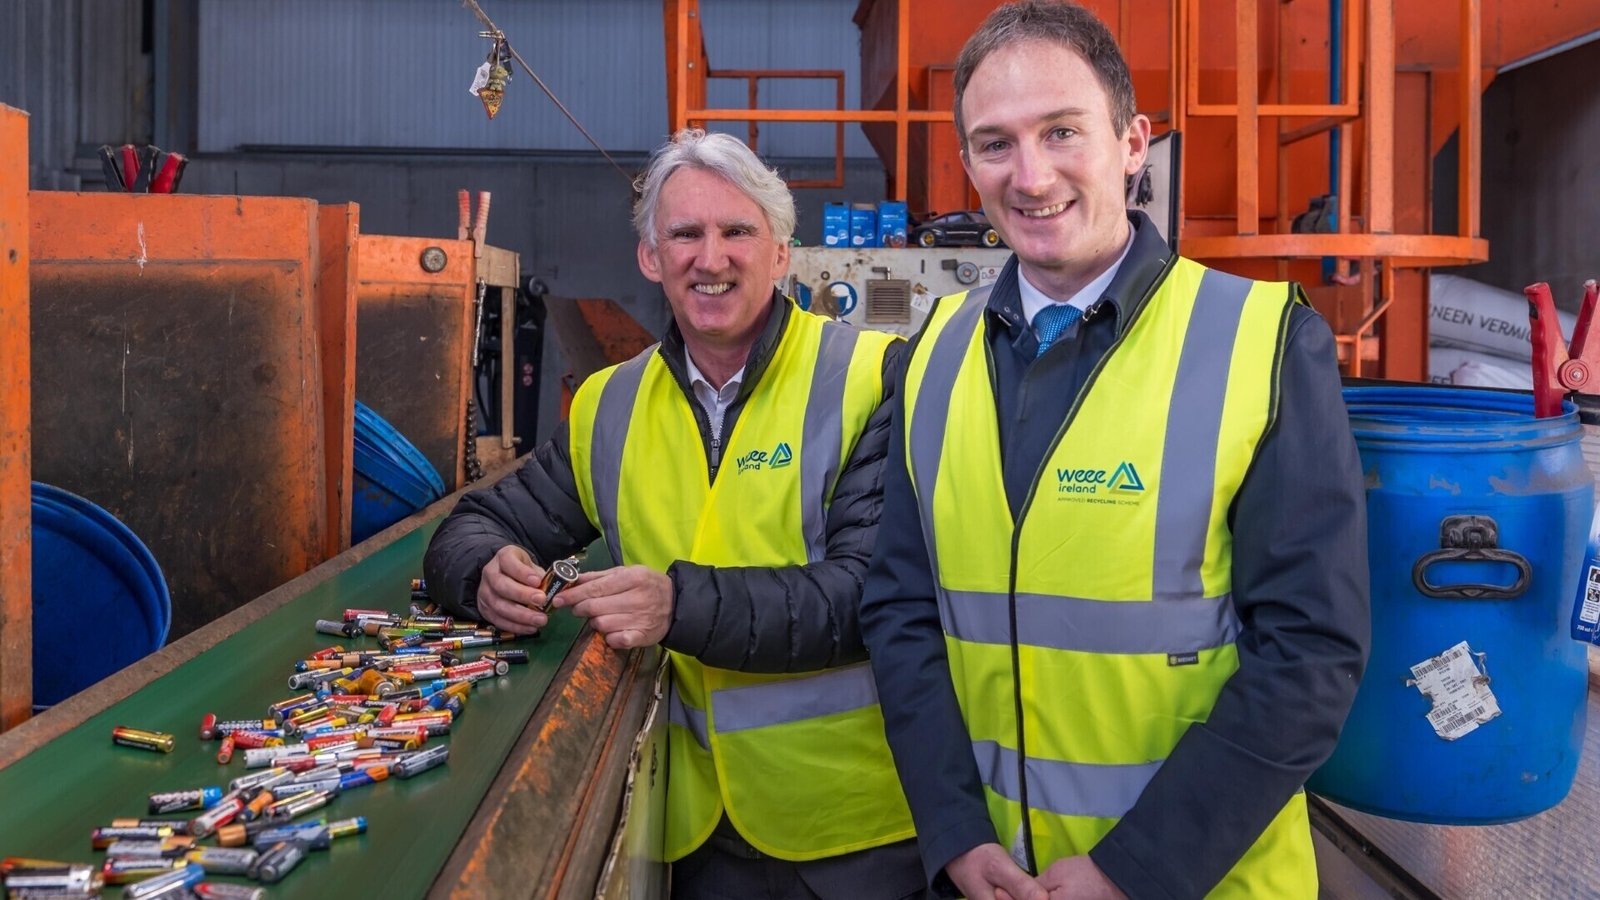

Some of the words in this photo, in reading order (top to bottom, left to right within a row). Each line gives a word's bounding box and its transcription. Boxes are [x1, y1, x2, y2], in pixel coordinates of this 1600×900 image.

[1428, 303, 1474, 326] NEEN
[1057, 468, 1106, 483] weee
[1058, 483, 1097, 494] ireland
